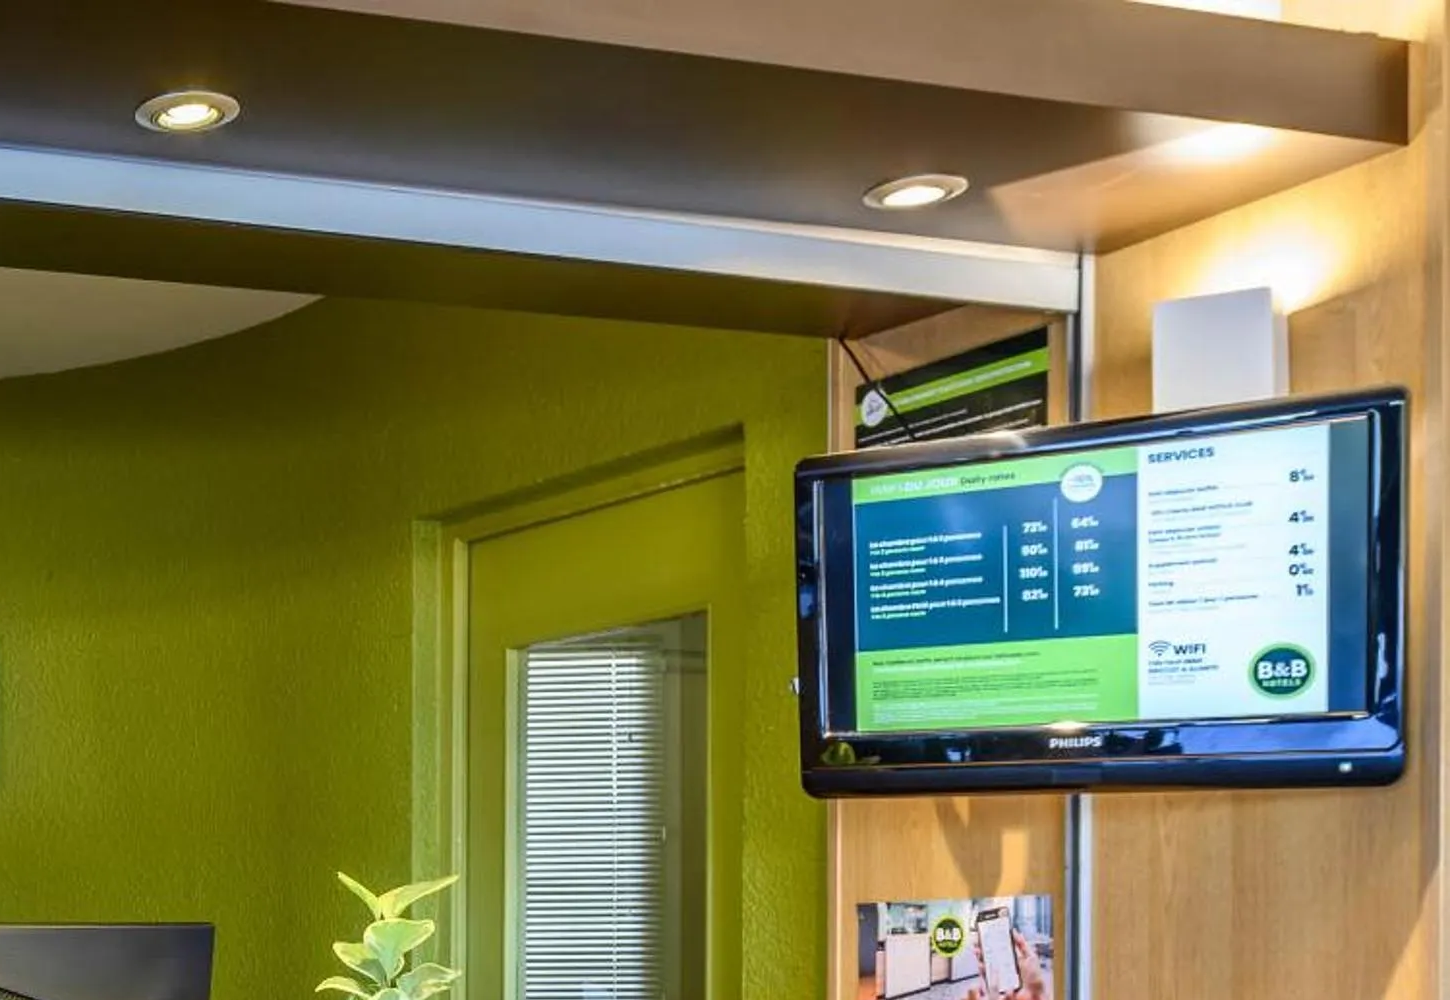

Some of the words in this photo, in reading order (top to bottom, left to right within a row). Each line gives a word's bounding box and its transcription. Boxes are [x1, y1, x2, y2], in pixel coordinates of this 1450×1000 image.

[1148, 446, 1215, 464] SERVICES
[1173, 643, 1206, 655] WIFI
[1258, 659, 1308, 680] B&B
[1049, 735, 1103, 749] PHILIPS
